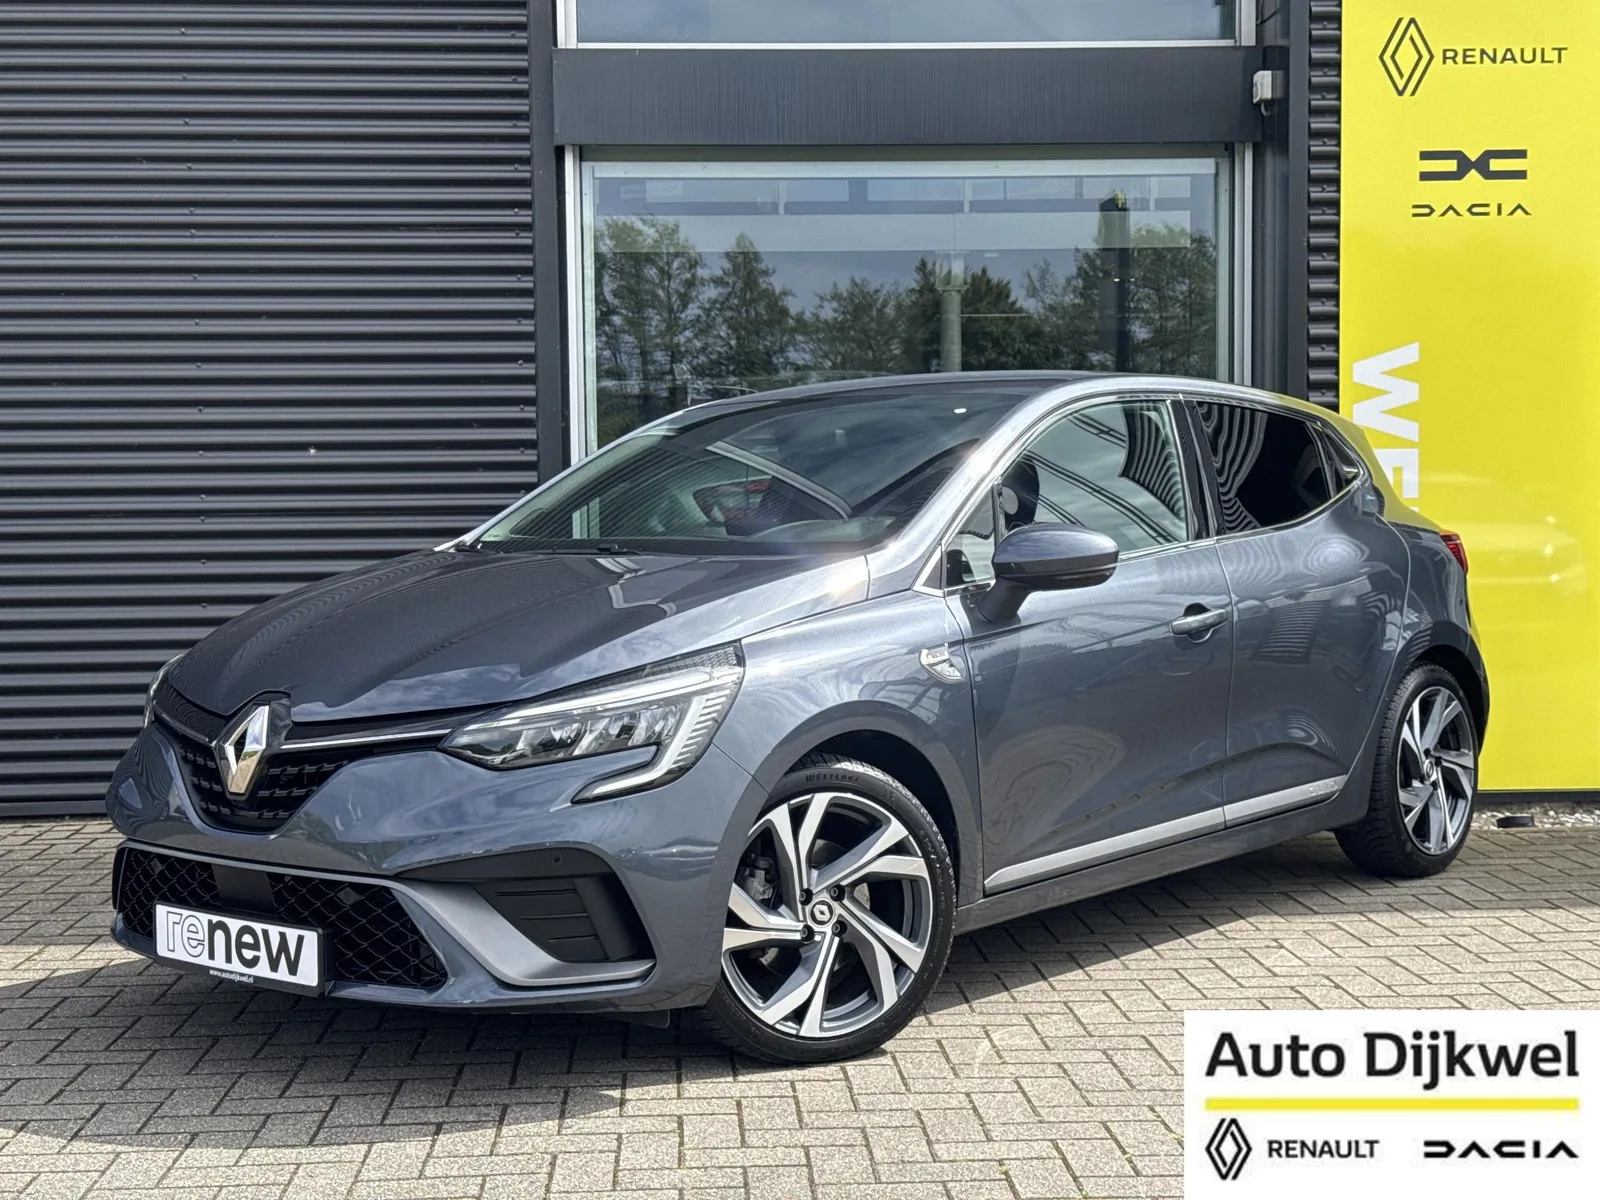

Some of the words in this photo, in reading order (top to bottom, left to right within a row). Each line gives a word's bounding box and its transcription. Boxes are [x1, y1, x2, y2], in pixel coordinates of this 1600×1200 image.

[1442, 47, 1567, 65] RENAULT
[1412, 203, 1532, 217] DACIA
[1352, 341, 1420, 512] WE
[167, 912, 305, 976] renew
